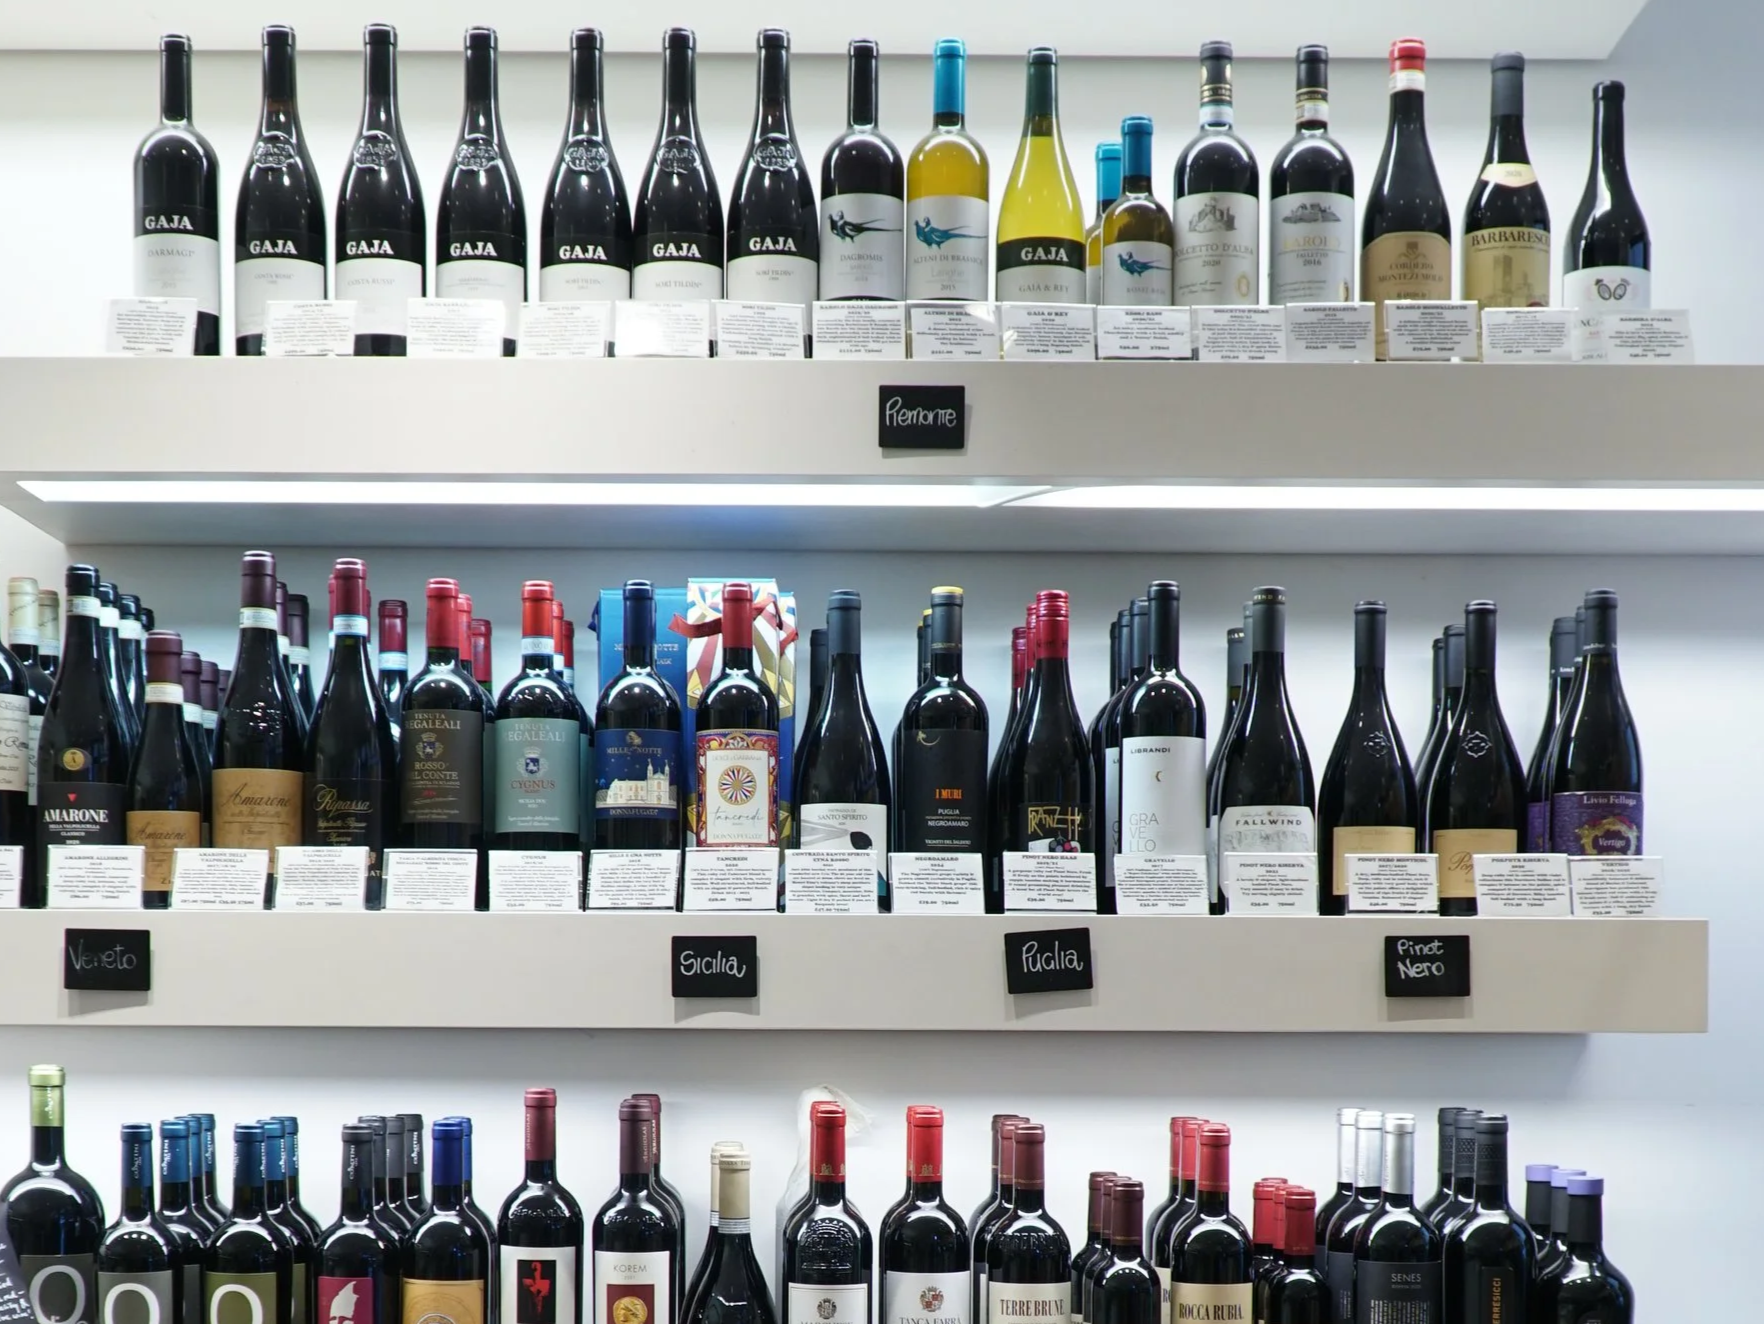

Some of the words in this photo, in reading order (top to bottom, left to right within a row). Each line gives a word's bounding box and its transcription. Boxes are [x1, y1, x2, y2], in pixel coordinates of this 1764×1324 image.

[144, 215, 194, 230] GAJA
[249, 239, 298, 255] GAJA
[346, 239, 394, 255] GAJA
[450, 241, 498, 257] GAJA
[652, 242, 702, 258] GAJA
[749, 236, 797, 252] GAJA
[559, 245, 607, 260] GAJA
[840, 253, 884, 263] DAGROMIS
[1021, 246, 1069, 263] GAJA
[1019, 283, 1042, 294] GAIA
[1052, 284, 1070, 294] REY
[886, 396, 957, 427] Piemonte
[1130, 746, 1171, 754] LIBRANDI
[414, 761, 446, 770] ROSSO
[510, 779, 556, 789] CYGNUS
[222, 782, 292, 809] Amarone
[942, 788, 962, 799] MURI
[1583, 795, 1607, 806] Livio
[43, 809, 109, 823] AMARONE
[817, 813, 841, 821] SANTO
[843, 813, 868, 821] SPIRITO
[927, 819, 969, 827] NEGROAMARO
[1129, 813, 1159, 826] GRA
[1235, 818, 1302, 826] FALLWIND
[1129, 826, 1147, 839] VE
[1129, 840, 1156, 852] LLO
[1397, 939, 1444, 956] Pinot
[68, 939, 136, 972] Veneto
[1022, 940, 1084, 973] Puglia
[680, 950, 746, 978] Sicilia
[1396, 958, 1445, 980] Nero
[612, 1264, 648, 1274] KOREM
[1391, 1273, 1422, 1283] SENES
[999, 1298, 1032, 1317] TERRE
[1034, 1298, 1066, 1317] BRUNE
[1178, 1302, 1210, 1321] ROCCA
[1213, 1303, 1243, 1321] RUBIA
